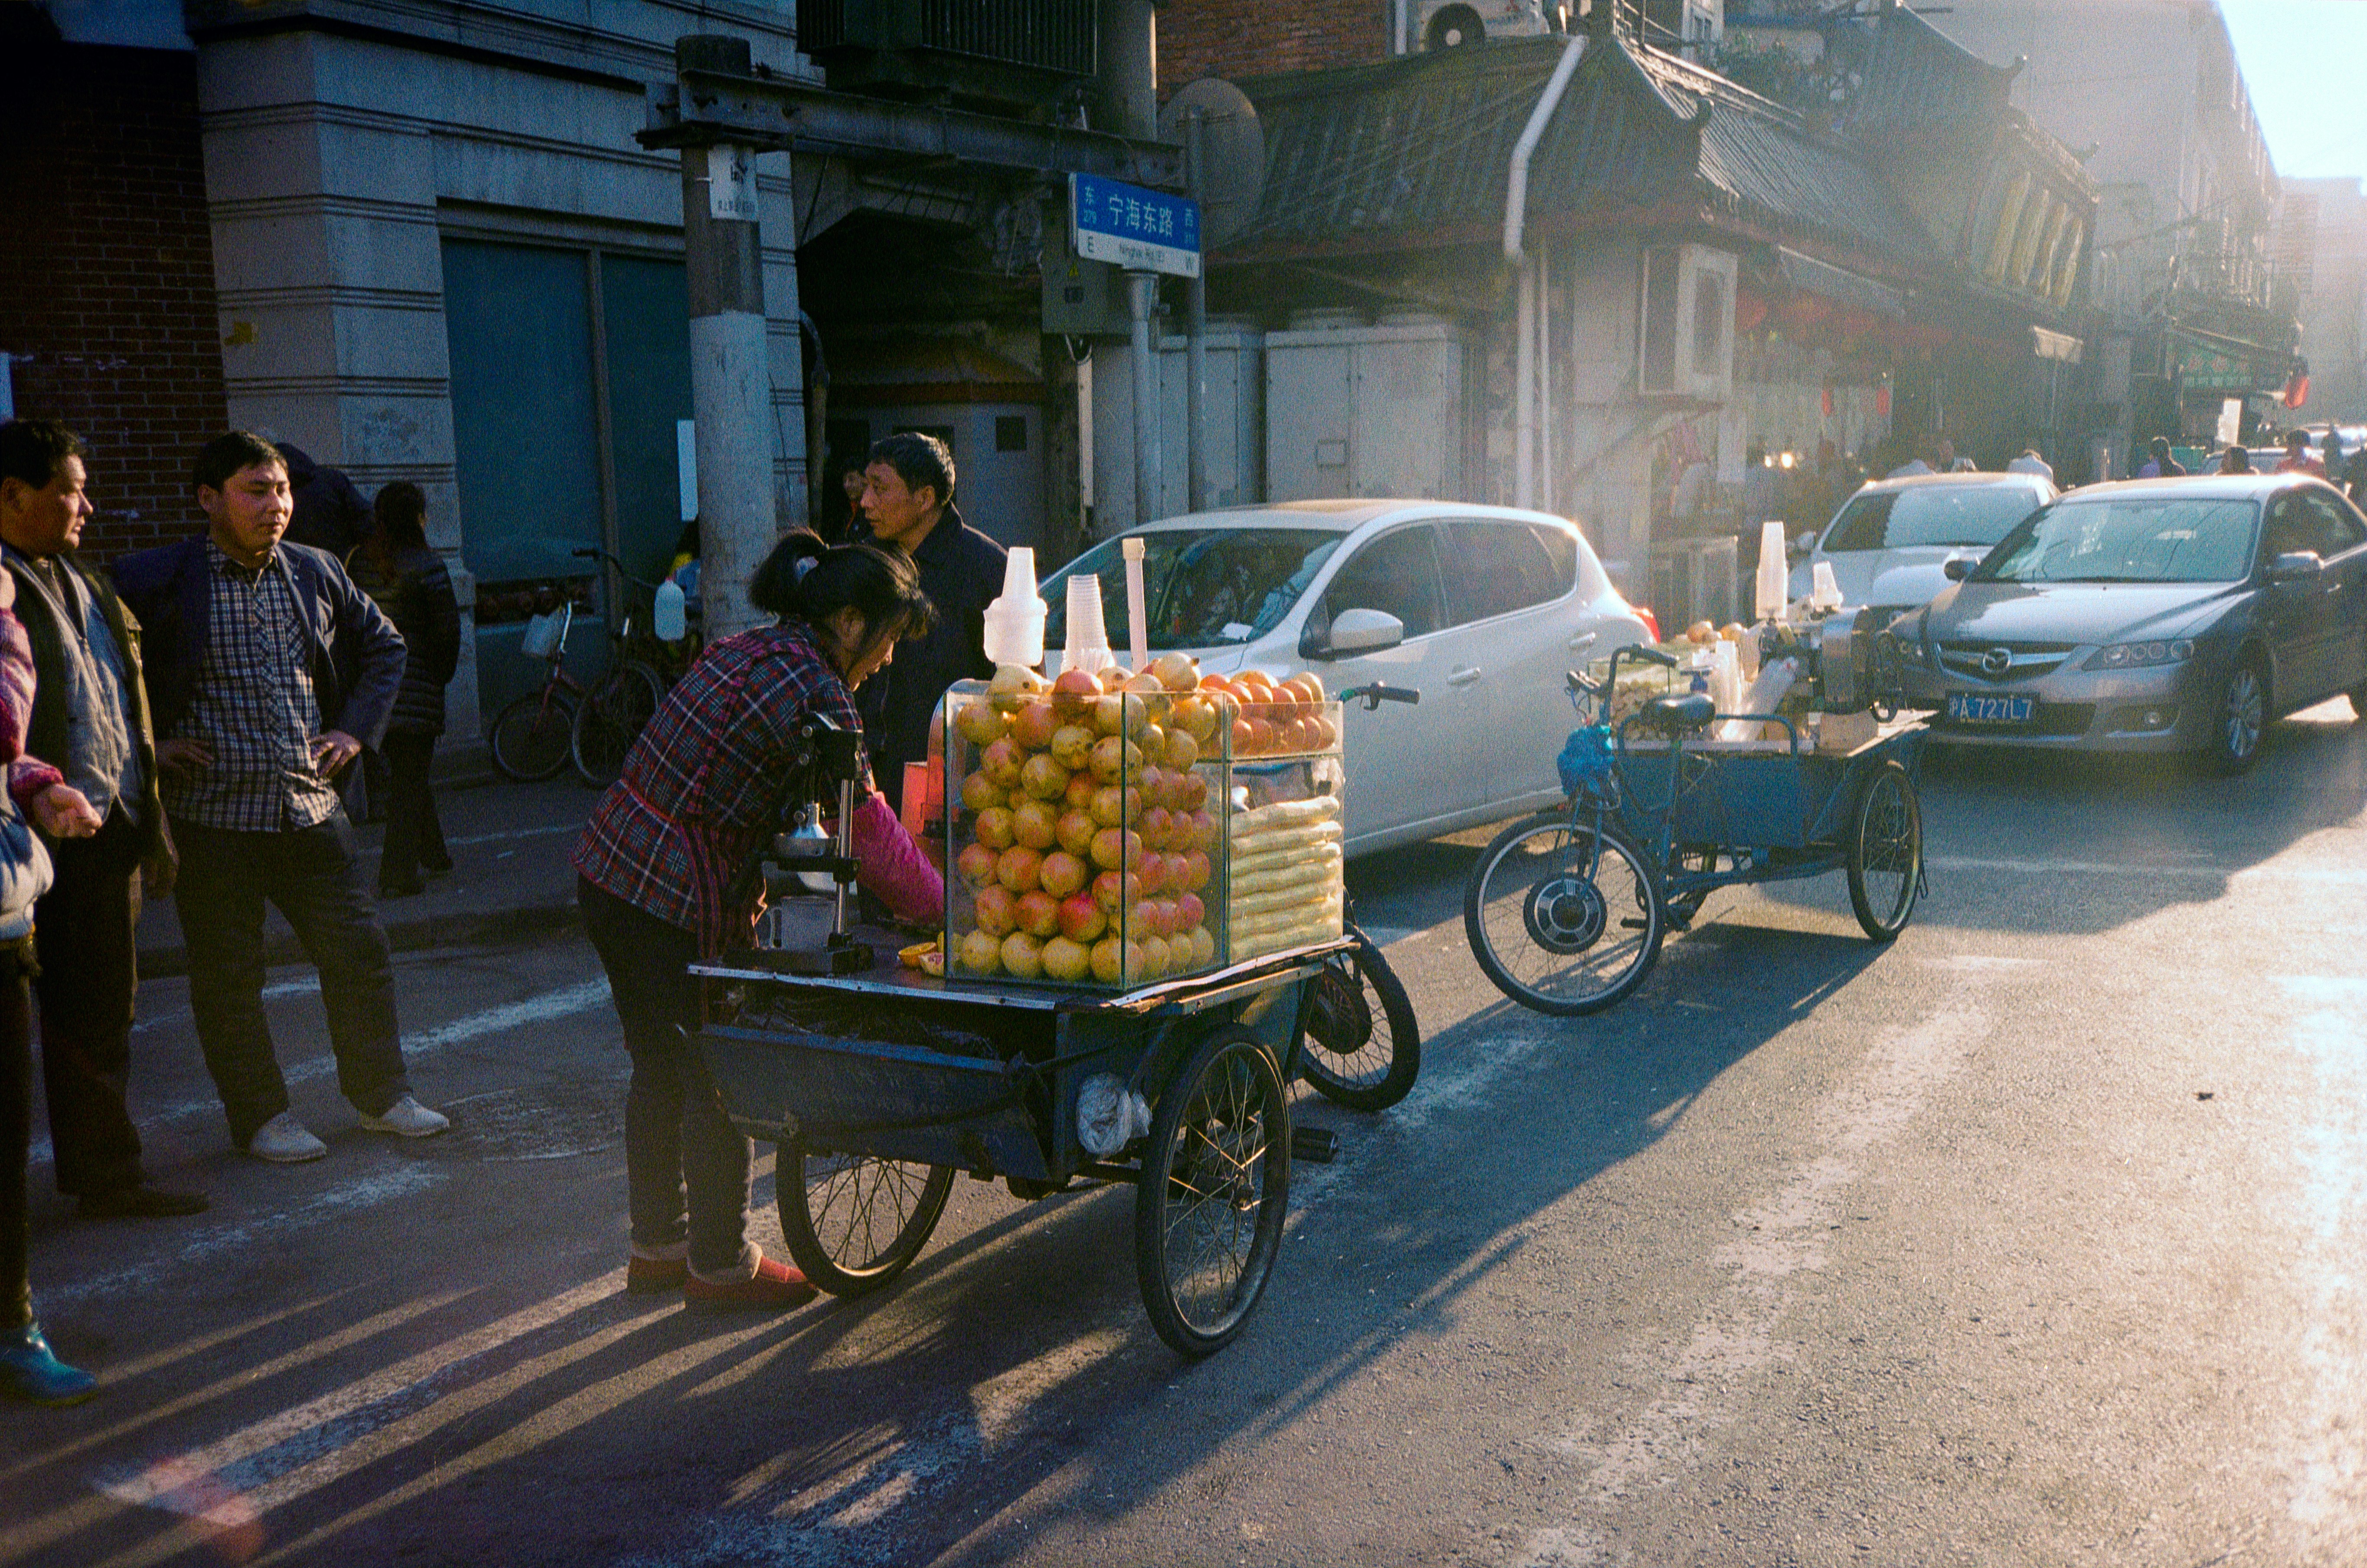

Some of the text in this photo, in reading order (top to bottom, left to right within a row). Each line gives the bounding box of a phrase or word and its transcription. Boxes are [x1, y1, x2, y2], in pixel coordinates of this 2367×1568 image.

[1084, 185, 1094, 206] 东
[1109, 193, 1173, 238] 宁海东路
[1088, 236, 1095, 254] E
